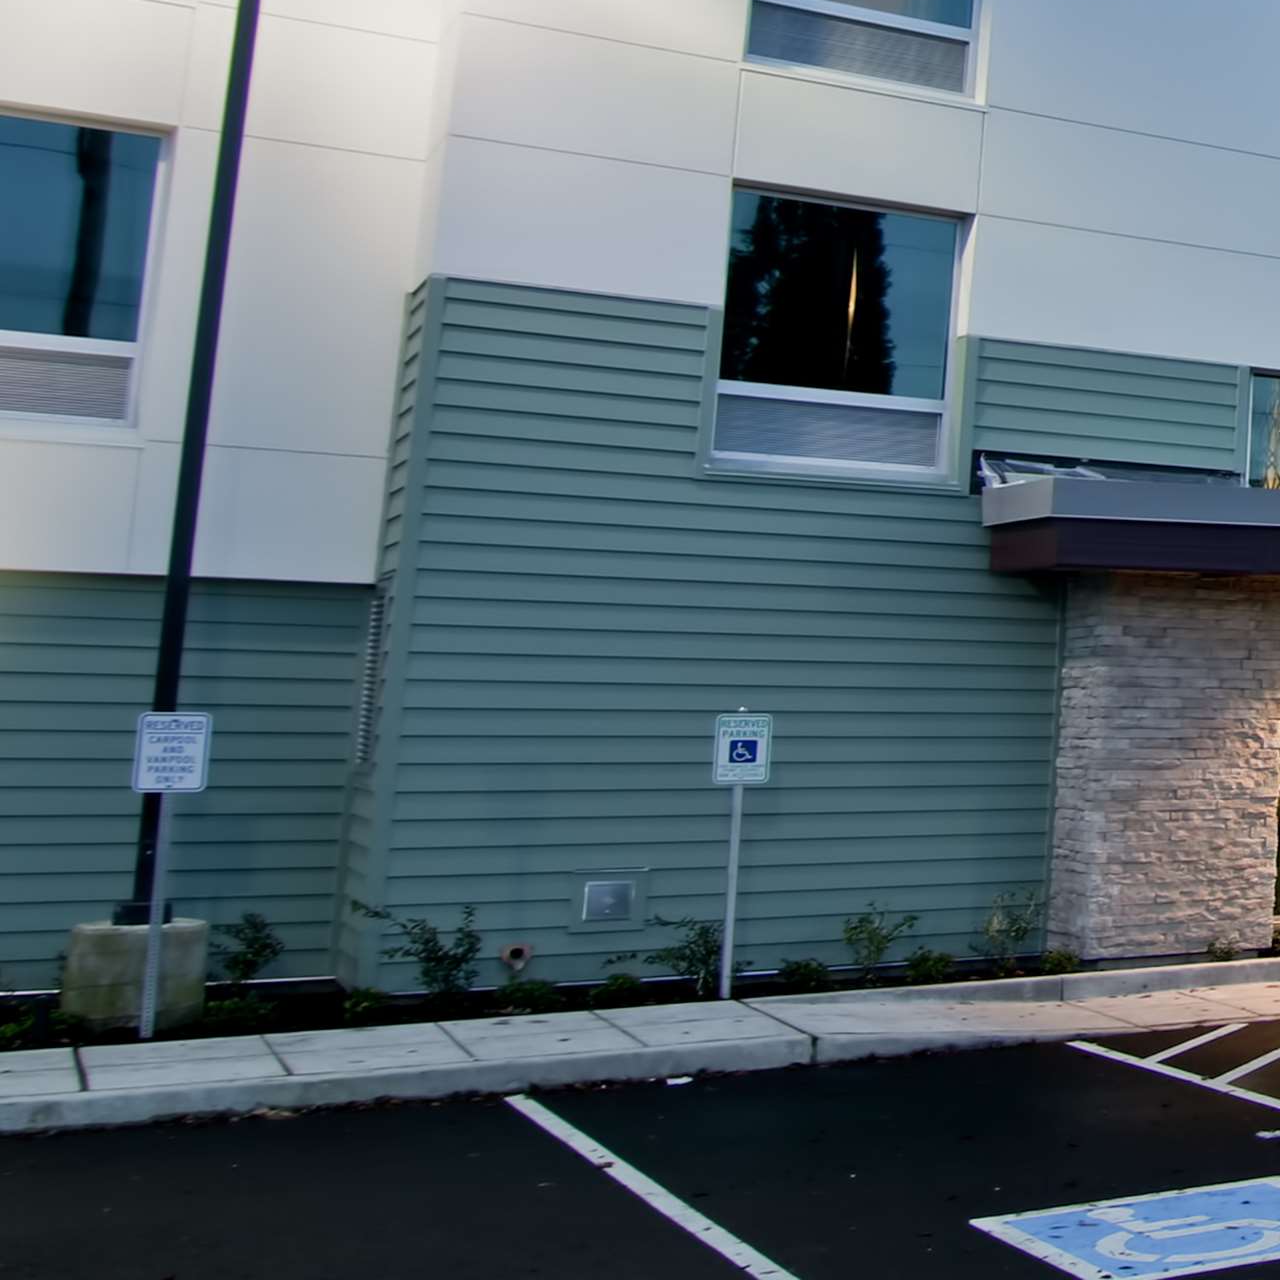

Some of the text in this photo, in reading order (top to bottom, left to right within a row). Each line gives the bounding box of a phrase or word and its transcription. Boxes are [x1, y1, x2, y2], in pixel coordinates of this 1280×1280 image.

[143, 720, 204, 731] RESERVED
[719, 719, 768, 728] RESERVED
[722, 729, 766, 737] PARKING
[147, 735, 197, 744] CARPOOL
[162, 745, 184, 754] AND
[146, 755, 196, 764] VANPOOL
[146, 765, 194, 774] PARKING
[154, 775, 185, 784] ONLY
